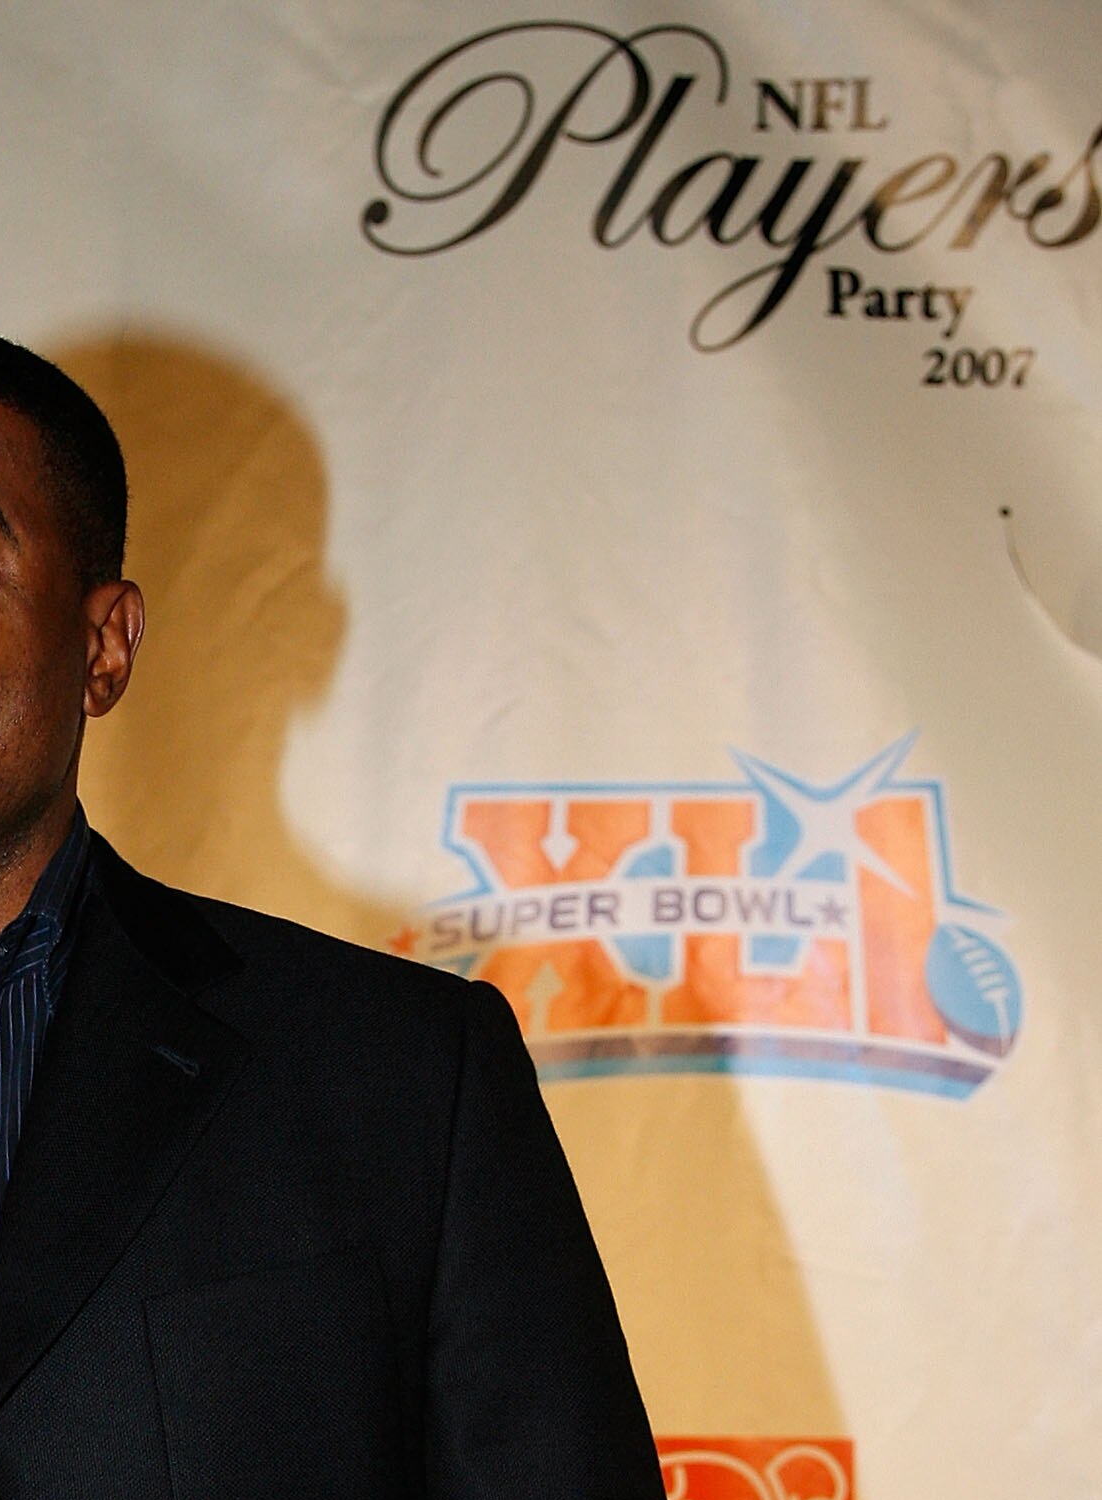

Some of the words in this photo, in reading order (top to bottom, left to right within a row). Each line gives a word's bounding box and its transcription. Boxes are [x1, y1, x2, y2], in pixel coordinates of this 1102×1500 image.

[754, 78, 887, 133] NFL
[361, 20, 1102, 354] Players
[827, 268, 977, 338] Party
[922, 348, 1036, 389] 2007
[430, 889, 619, 951] SUPER
[652, 887, 814, 929] BOWL
